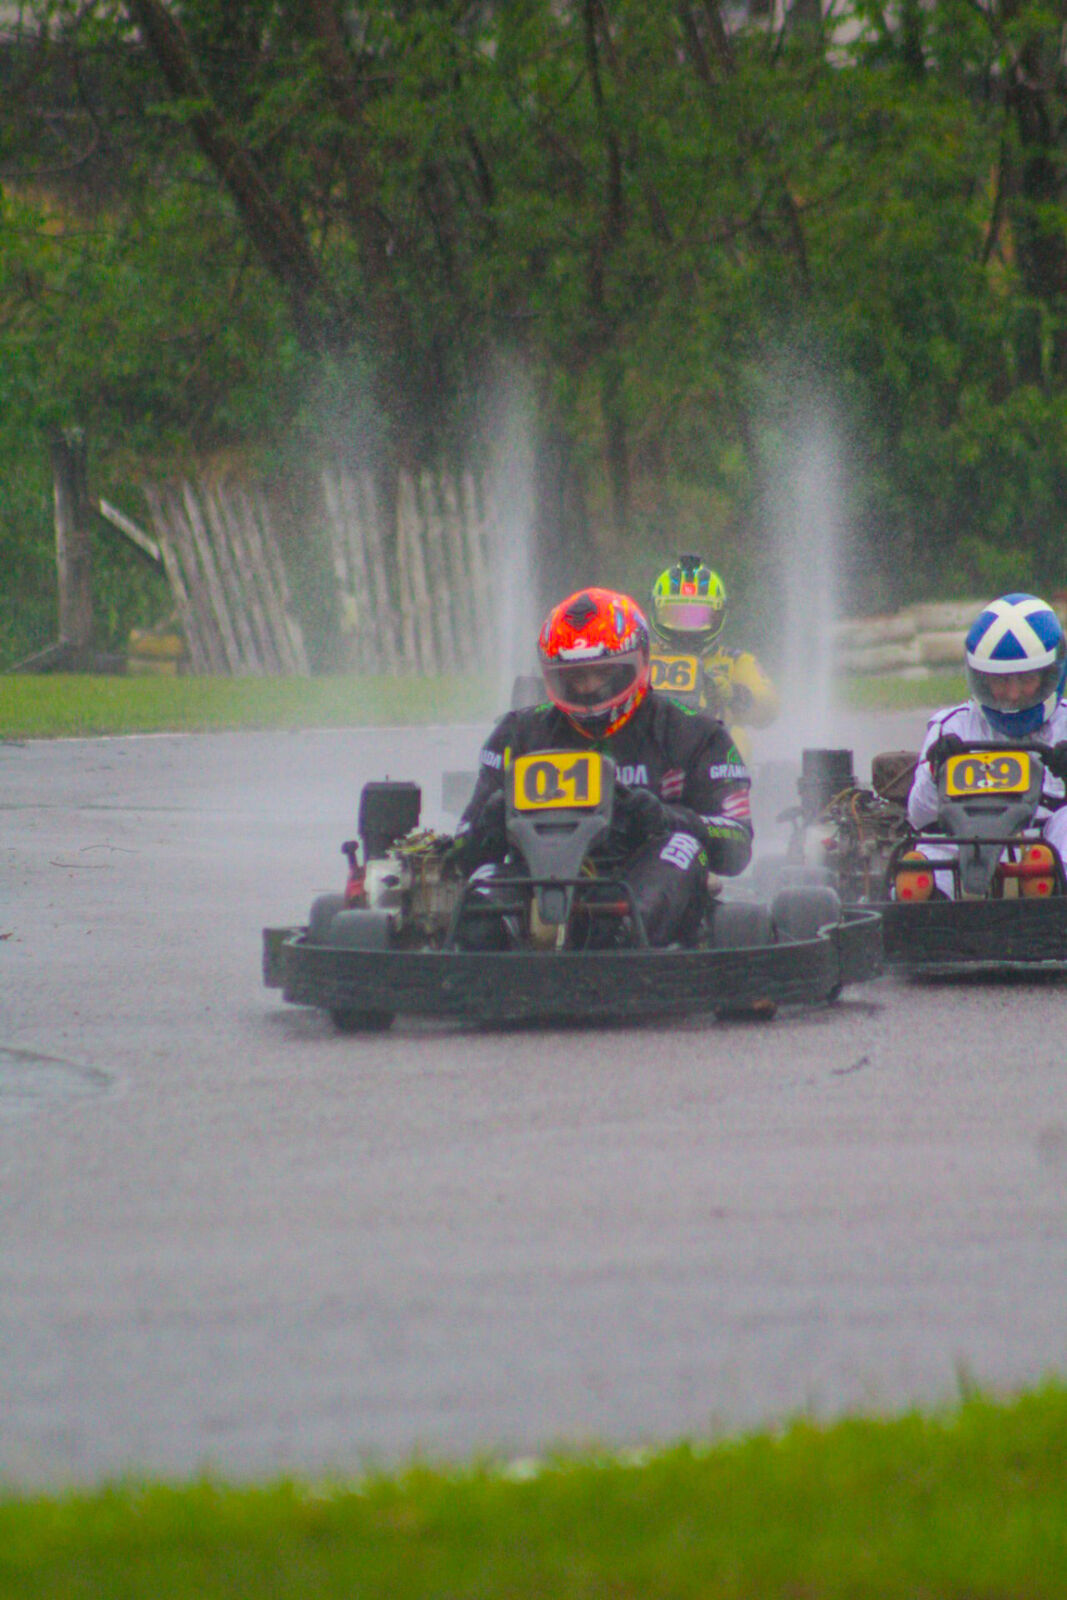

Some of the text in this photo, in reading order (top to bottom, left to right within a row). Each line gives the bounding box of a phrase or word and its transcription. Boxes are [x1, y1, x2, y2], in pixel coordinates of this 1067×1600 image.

[650, 659, 692, 687] 06
[523, 758, 589, 804] 01
[953, 757, 1023, 791] 09
